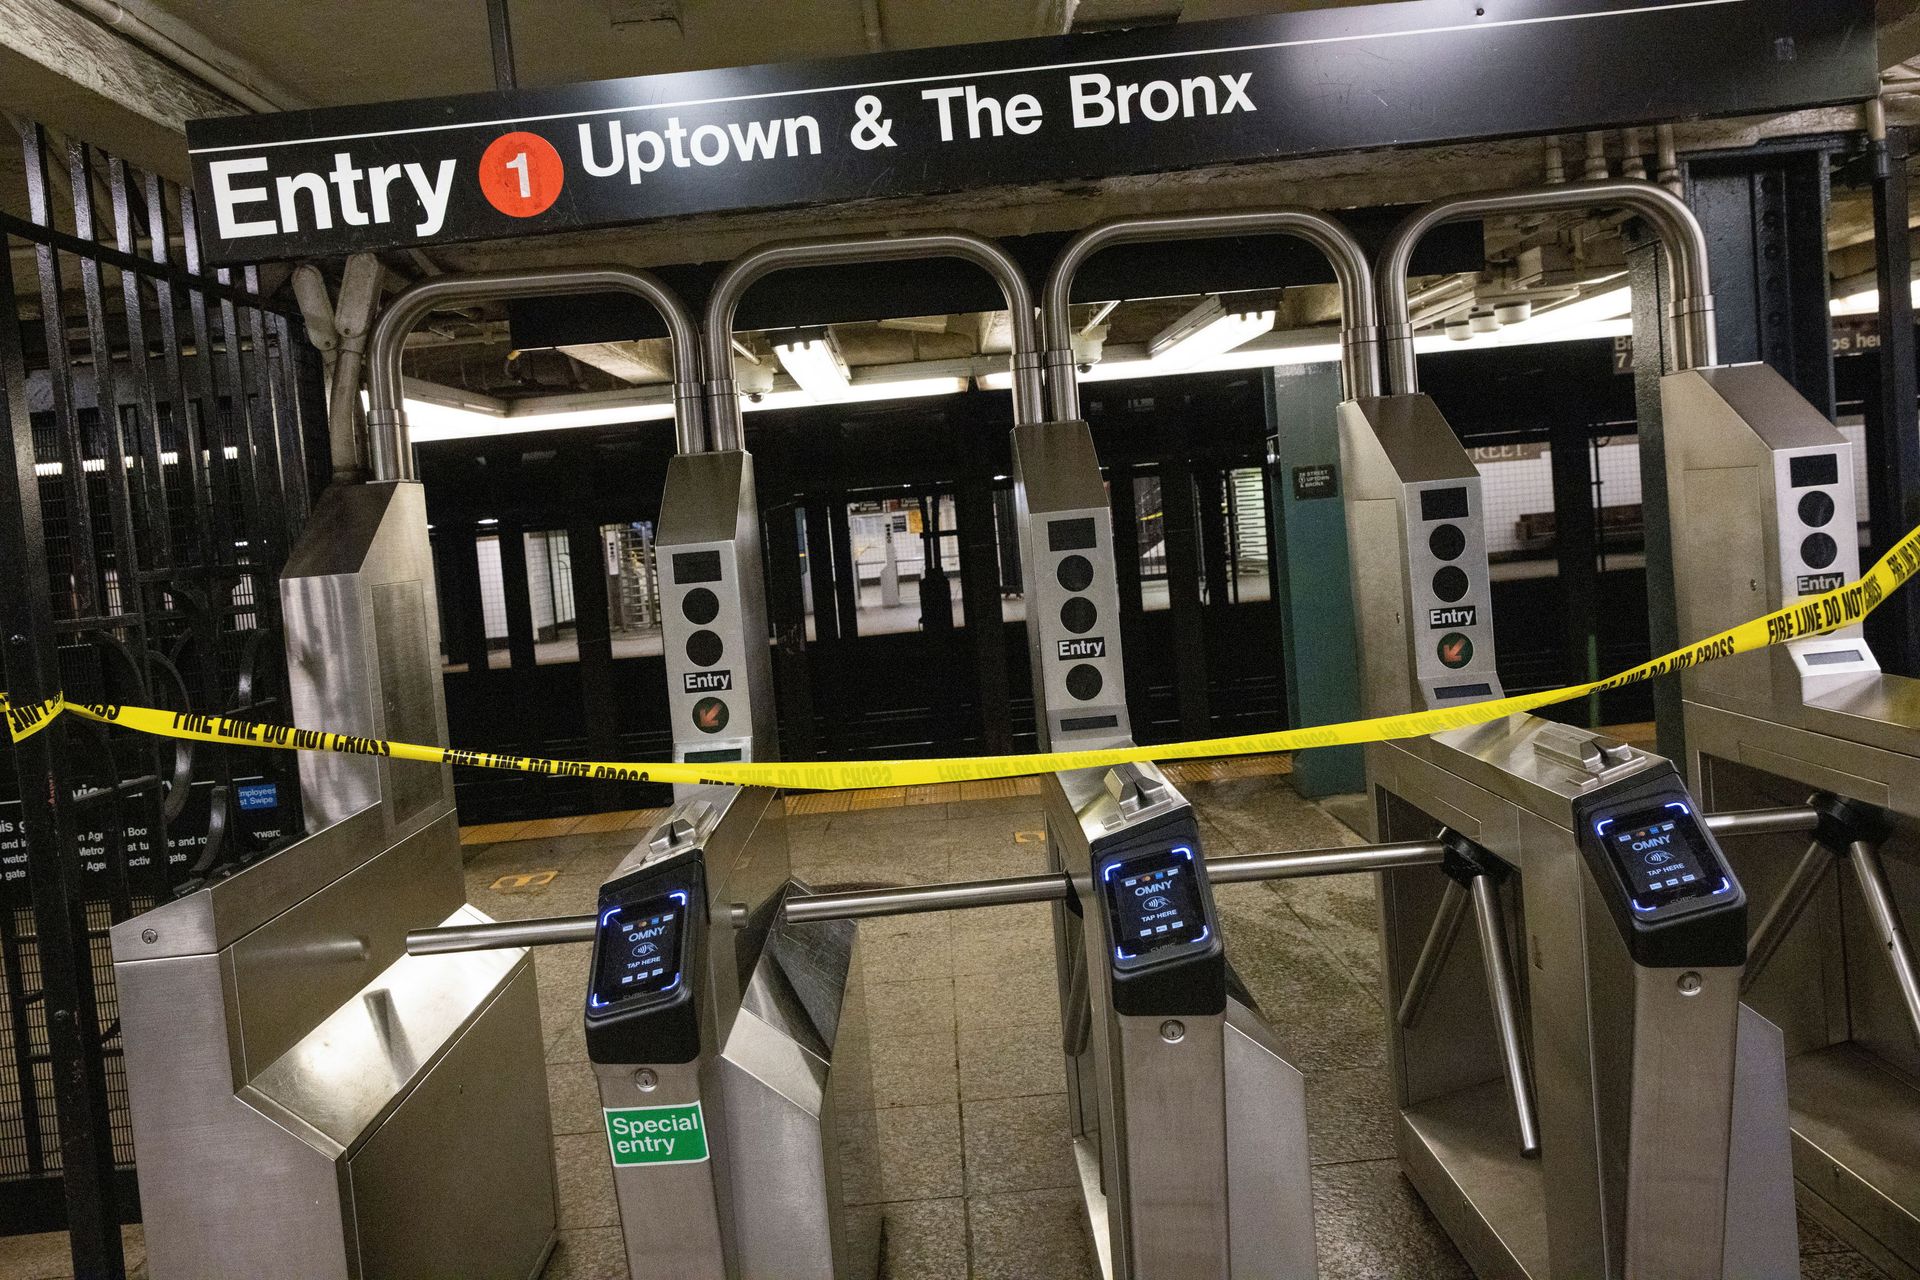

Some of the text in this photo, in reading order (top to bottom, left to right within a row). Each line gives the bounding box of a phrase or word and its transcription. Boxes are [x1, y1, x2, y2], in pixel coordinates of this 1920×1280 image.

[209, 71, 1257, 239] Entry 1 Uptown & The Bronx
[1798, 576, 1842, 592] Entry
[1430, 609, 1473, 625] Entry
[1767, 613, 1793, 645] FIRE
[1795, 602, 1822, 635] LINE
[1823, 596, 1841, 626] DO
[1841, 586, 1864, 620] NOT
[1059, 640, 1103, 656] Entry
[1650, 661, 1666, 678] DO
[1670, 651, 1693, 672] NOT
[1695, 635, 1735, 665] CROSS
[685, 673, 729, 689] Entry
[173, 712, 391, 757] FIRE LINE DO NOT CROSS
[442, 748, 479, 767] FIRE
[485, 752, 523, 770] LINE
[528, 758, 551, 773] DO
[556, 761, 591, 777] NOT
[250, 796, 273, 806] Swipe
[1, 839, 18, 850] and
[127, 842, 137, 852] at
[178, 836, 195, 847] and
[1632, 834, 1671, 851] OMNY
[5, 869, 26, 880] gate
[1646, 863, 1685, 876] TAP HERE
[1134, 880, 1173, 896] OMNY
[1141, 909, 1178, 923] TAP HERE
[628, 925, 666, 942] OMNY
[627, 956, 661, 969] TAP HERE
[612, 1112, 699, 1138] Special
[616, 1137, 675, 1155] entry
